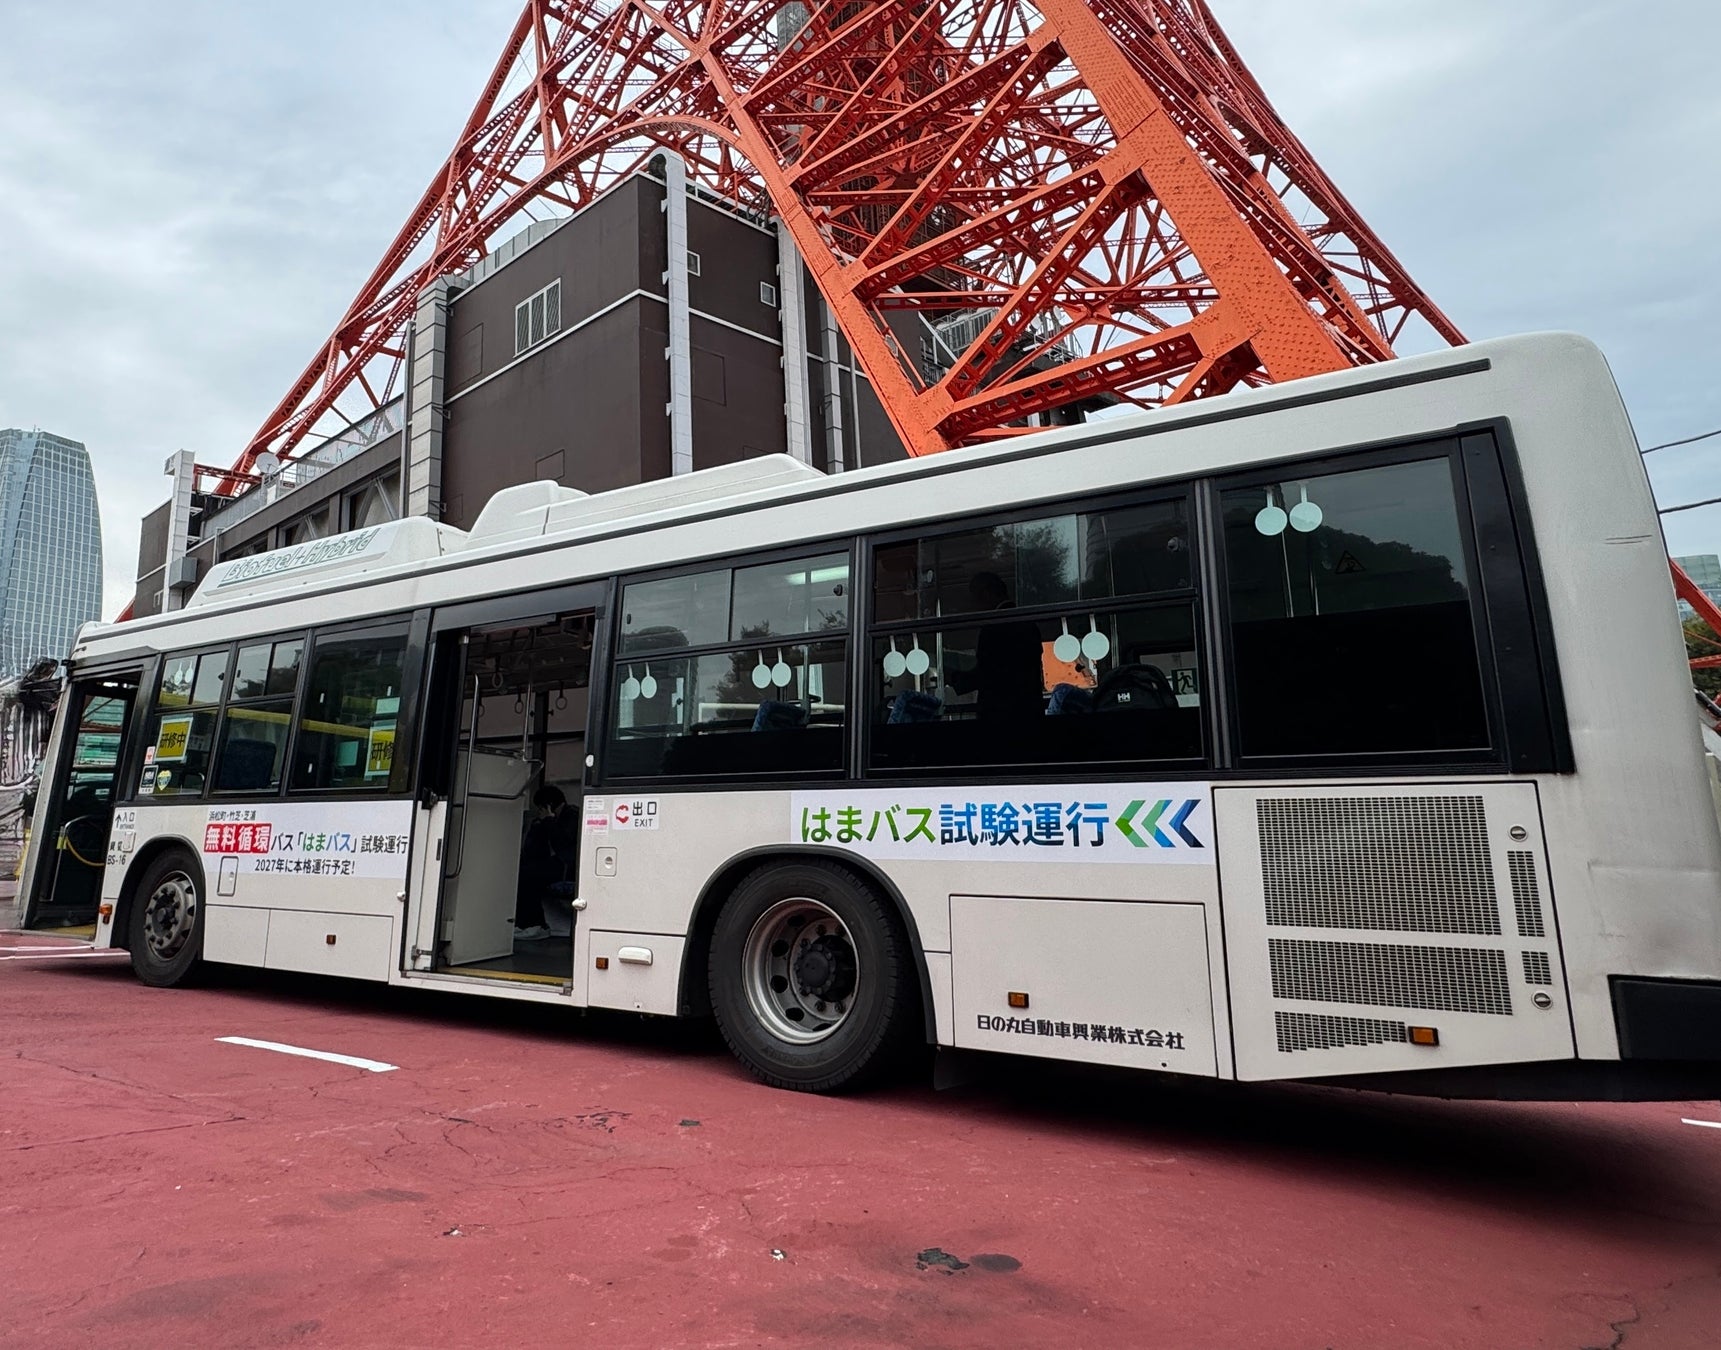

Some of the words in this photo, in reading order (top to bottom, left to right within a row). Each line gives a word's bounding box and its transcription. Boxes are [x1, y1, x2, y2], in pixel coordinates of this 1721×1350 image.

[159, 731, 186, 749] 研修中
[632, 801, 657, 816] 出口
[122, 811, 135, 823] 入口
[634, 818, 654, 828] EXIT
[800, 800, 1110, 849] はまバス試験運行
[976, 1013, 1187, 1051] 日の丸自動車興業株式会社
